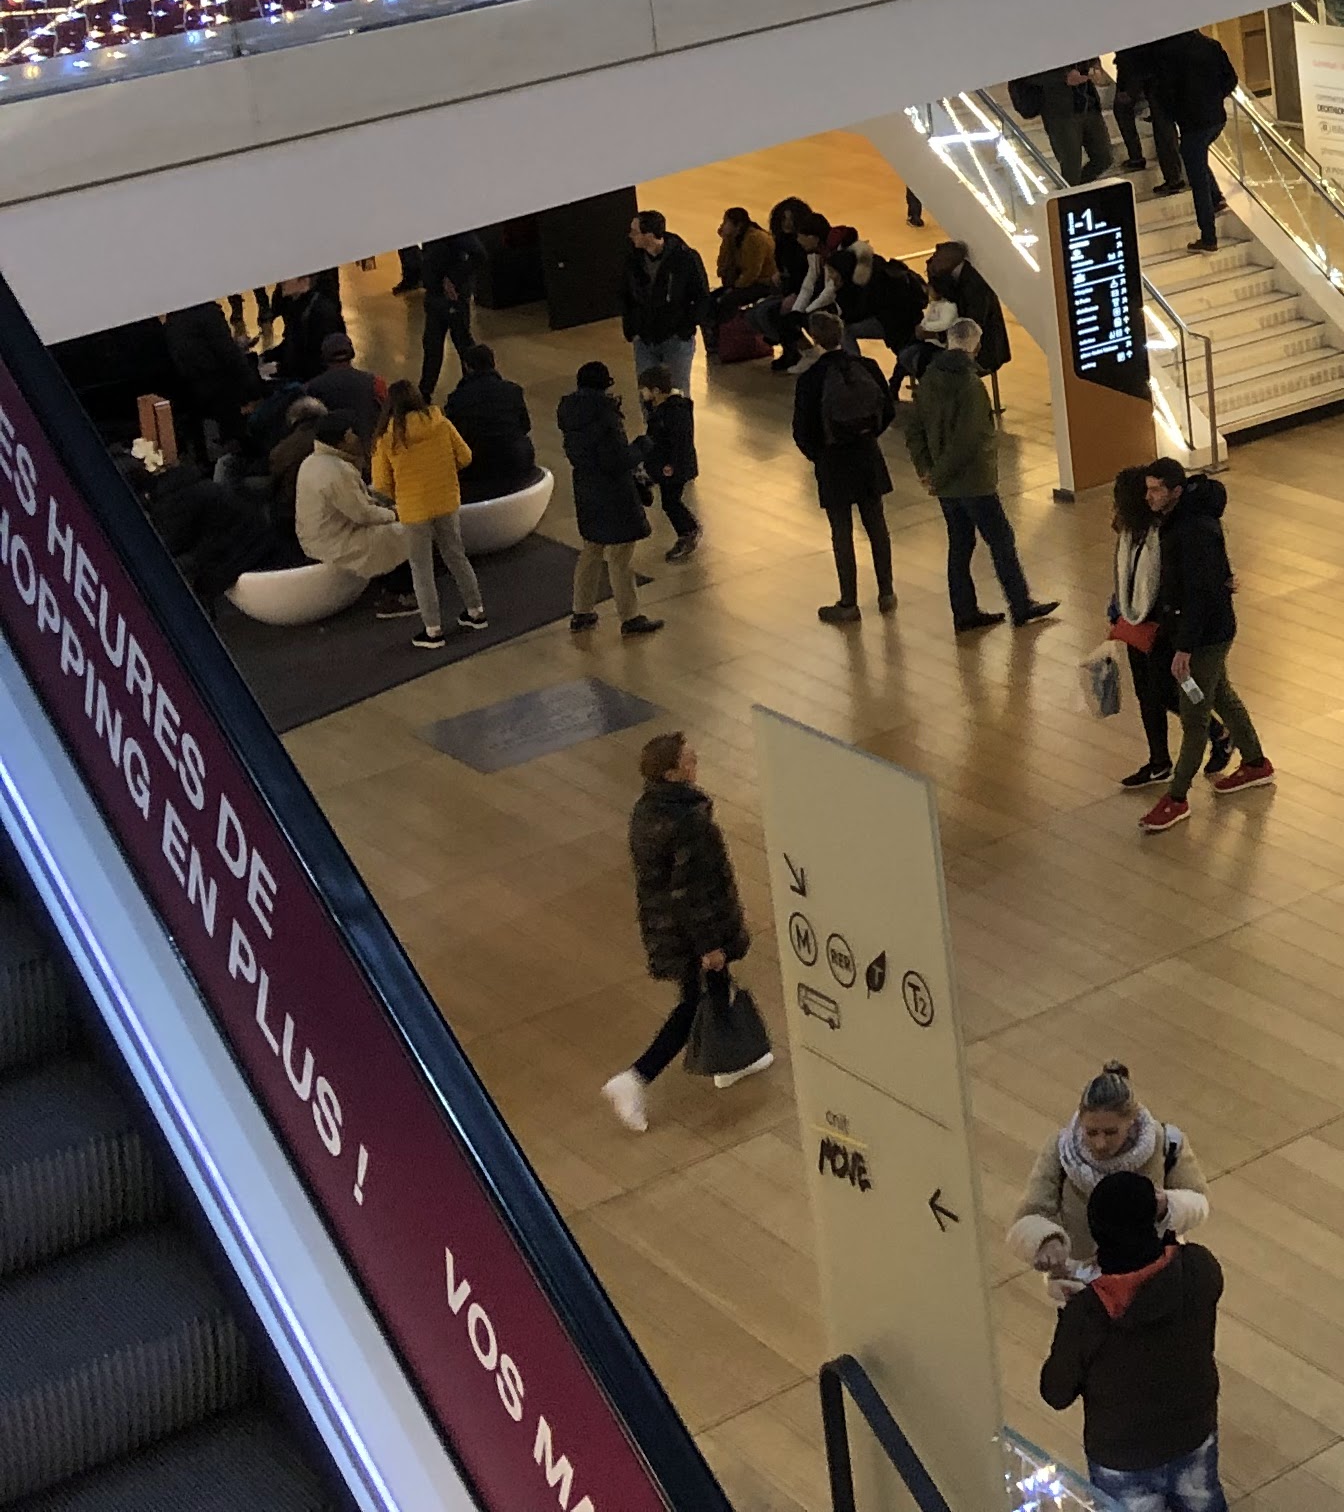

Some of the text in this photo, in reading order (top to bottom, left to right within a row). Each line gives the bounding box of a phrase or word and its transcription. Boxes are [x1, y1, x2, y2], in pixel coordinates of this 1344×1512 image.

[46, 494, 206, 811] HEURES
[216, 792, 278, 939] DE
[163, 799, 218, 938] EN
[228, 917, 343, 1157] PLUS
[907, 979, 928, 1018] T2
[445, 1246, 525, 1423] VOS
